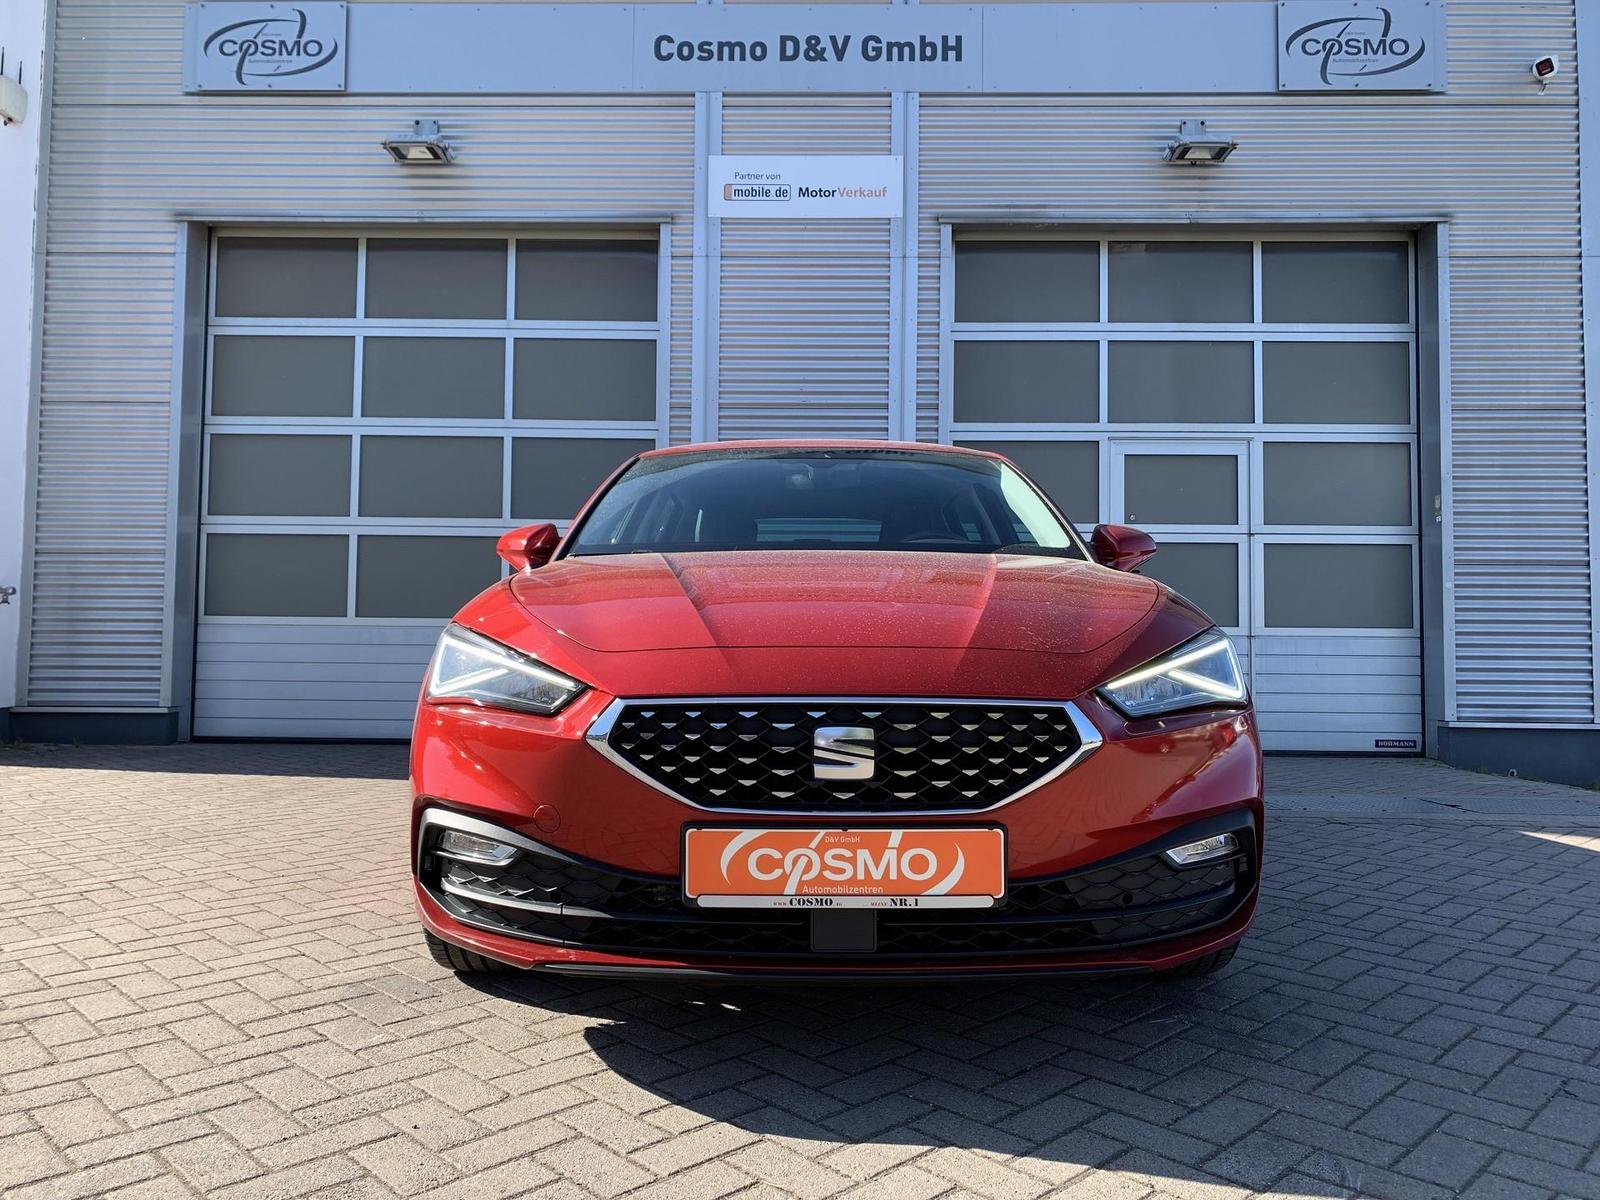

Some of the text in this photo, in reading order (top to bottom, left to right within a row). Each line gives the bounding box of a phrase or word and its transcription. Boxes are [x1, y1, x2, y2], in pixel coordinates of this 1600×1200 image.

[219, 39, 323, 57] COSMO
[653, 35, 963, 62] Cosmo D&V GmbH
[1301, 38, 1410, 56] COSMO
[734, 172, 763, 180] Partner
[733, 186, 789, 198] mobile.de
[747, 847, 938, 881] COSMO
[802, 884, 884, 894] Automobilzentren
[789, 897, 834, 907] COSMO
[889, 898, 919, 907] NR.1
